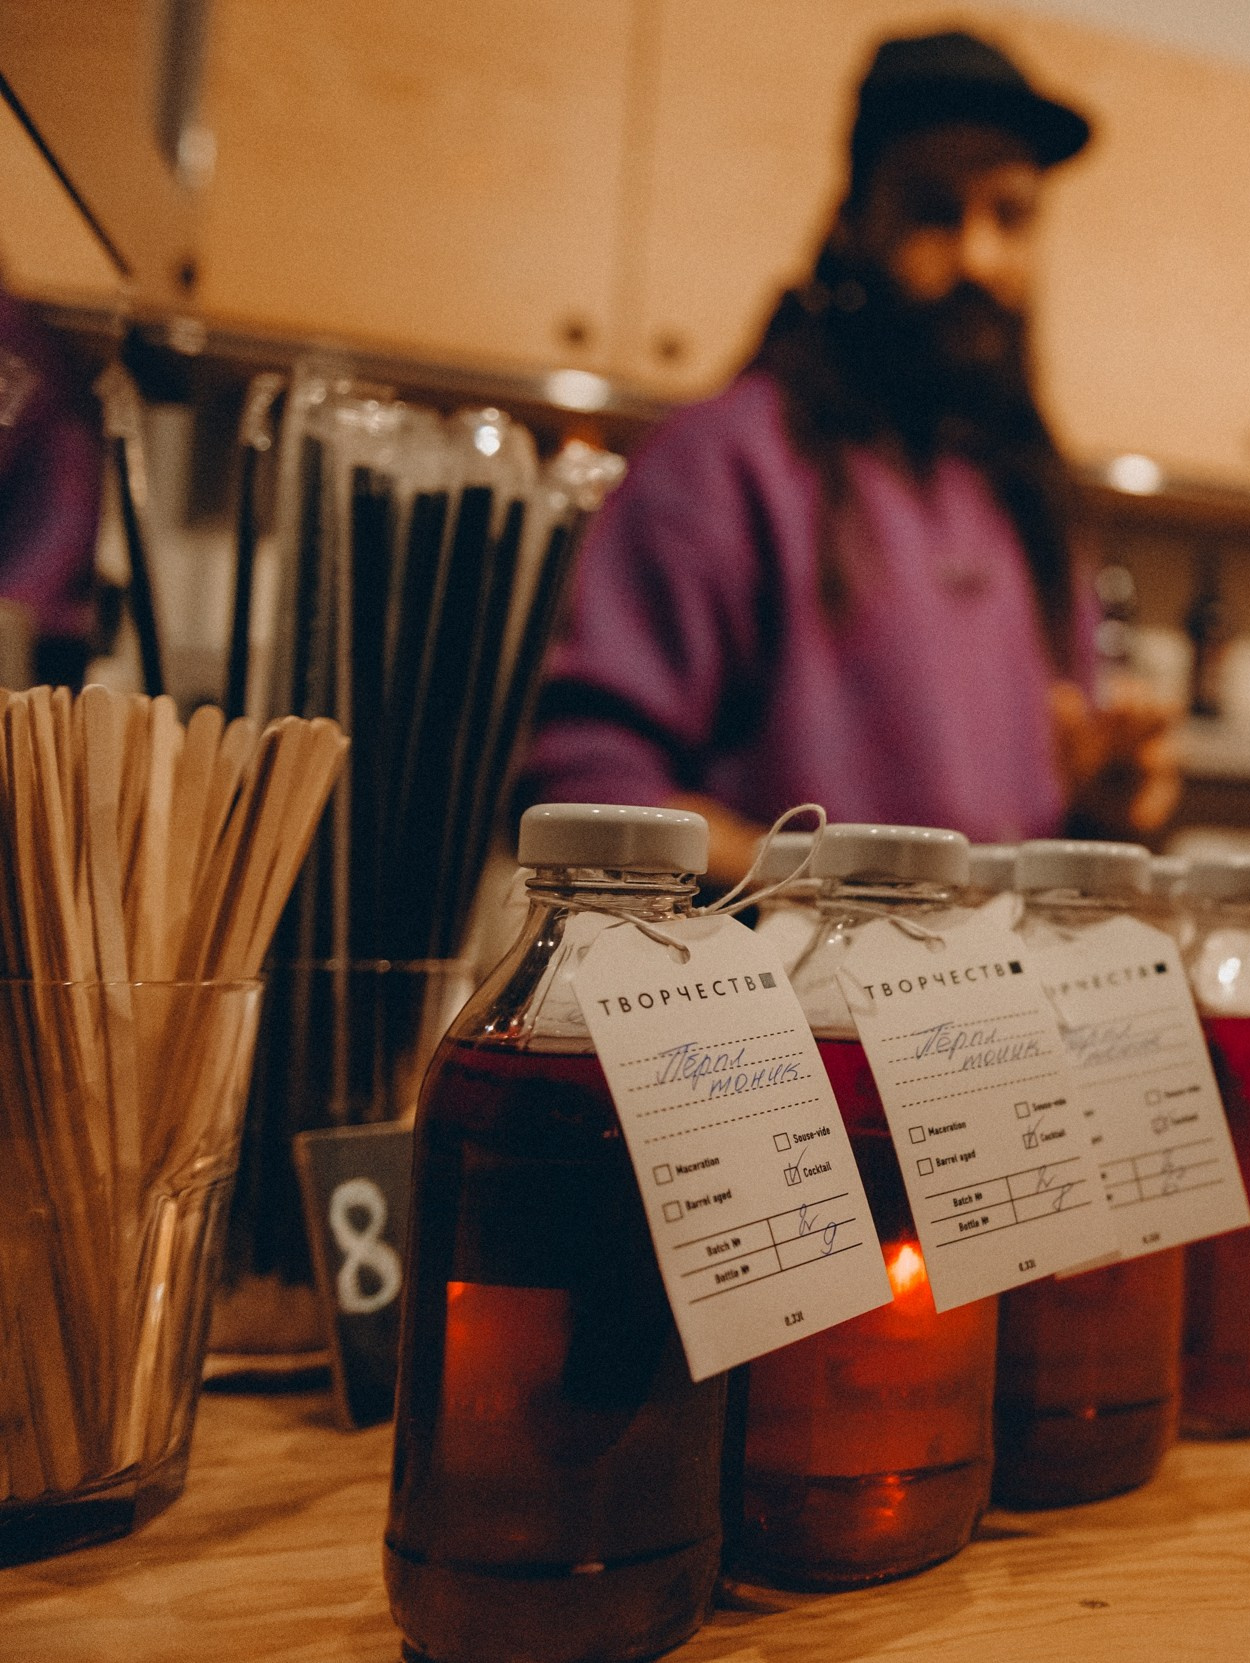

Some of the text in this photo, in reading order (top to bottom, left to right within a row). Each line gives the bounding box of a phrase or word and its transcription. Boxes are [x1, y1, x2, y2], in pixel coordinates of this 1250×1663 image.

[793, 1126, 831, 1145] Souse-vide
[928, 1120, 967, 1137] Maceration
[936, 1149, 976, 1168] Barrel aged
[803, 1161, 832, 1178] Cocktail
[685, 1188, 732, 1210] Barrel aged
[953, 1194, 973, 1208] Batch
[958, 1219, 980, 1233] Bottle
[330, 1176, 401, 1314] 8
[706, 1241, 730, 1256] Batch
[715, 1269, 739, 1284] Bottle
